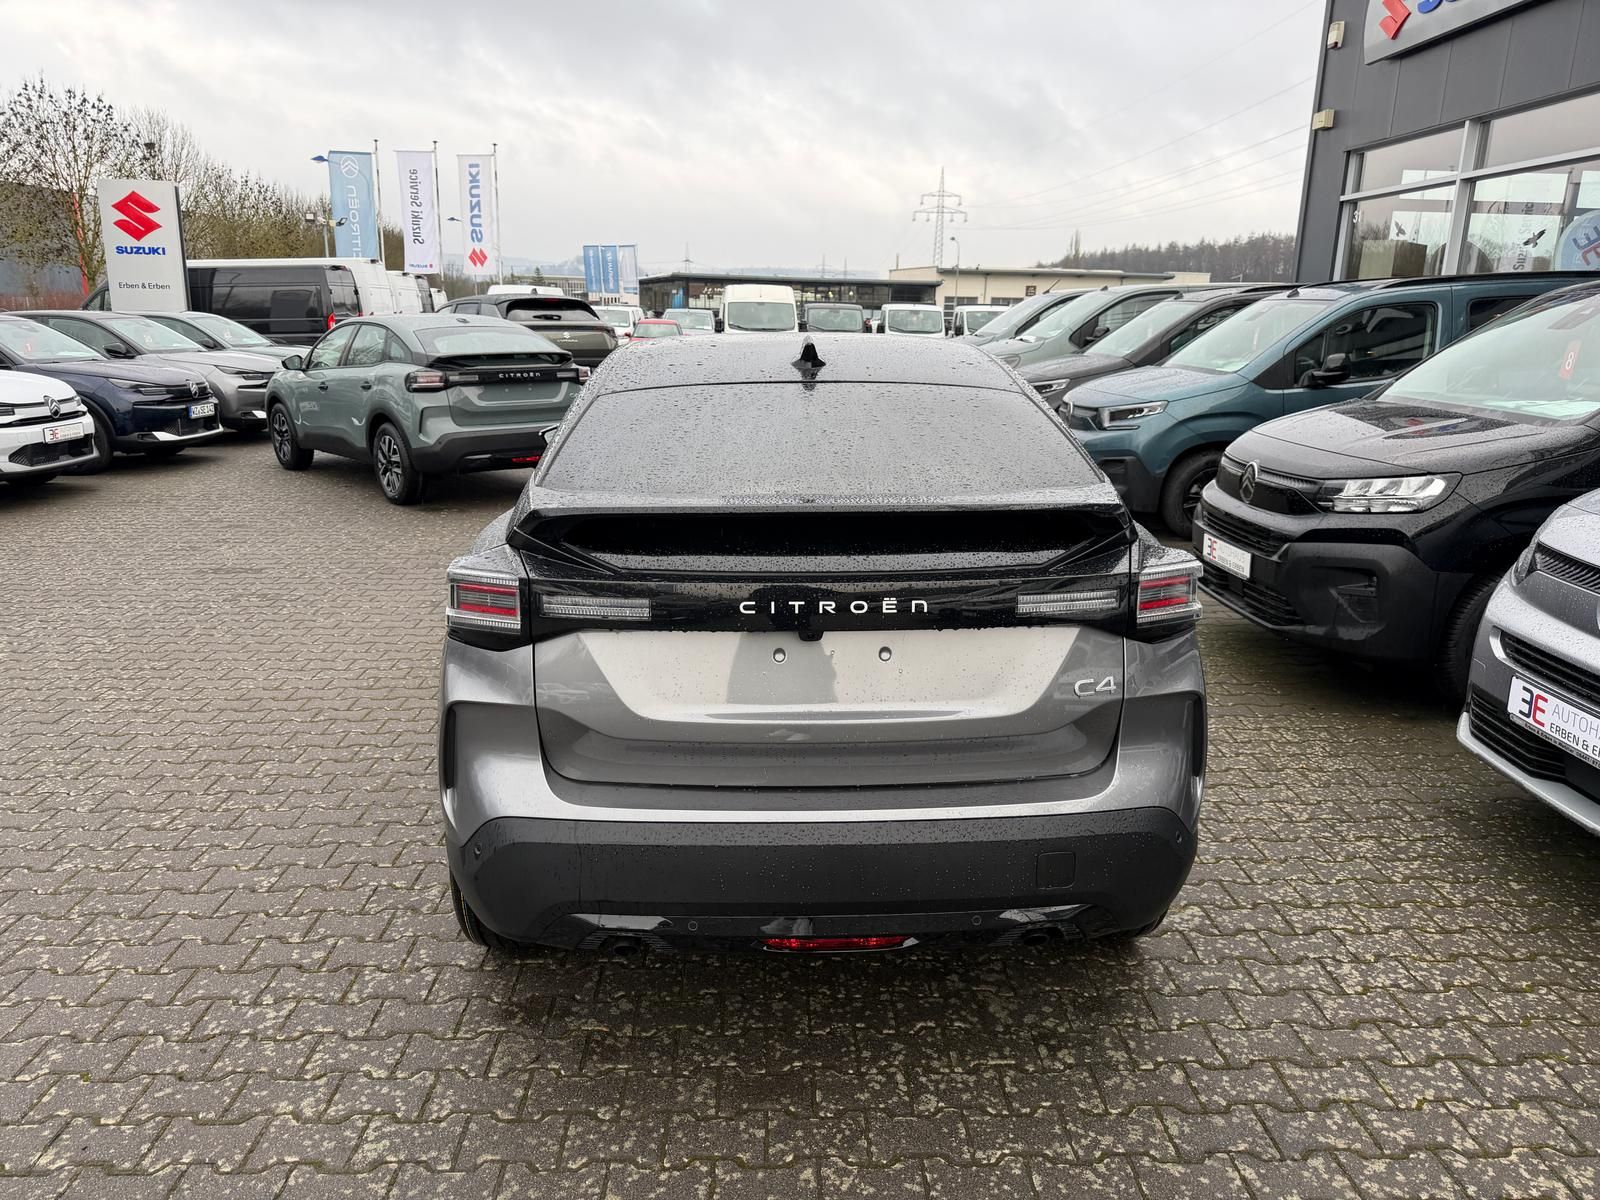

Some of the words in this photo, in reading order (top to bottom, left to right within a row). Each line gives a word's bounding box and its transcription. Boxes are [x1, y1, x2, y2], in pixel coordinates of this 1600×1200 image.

[115, 245, 166, 256] SUZUKI
[118, 281, 140, 290] Erben
[141, 282, 147, 290] &
[148, 282, 171, 291] Erben
[1074, 676, 1116, 696] C4
[1551, 703, 1600, 740] AUTOH
[1549, 722, 1580, 747] ERBEN
[1581, 739, 1590, 752] &
